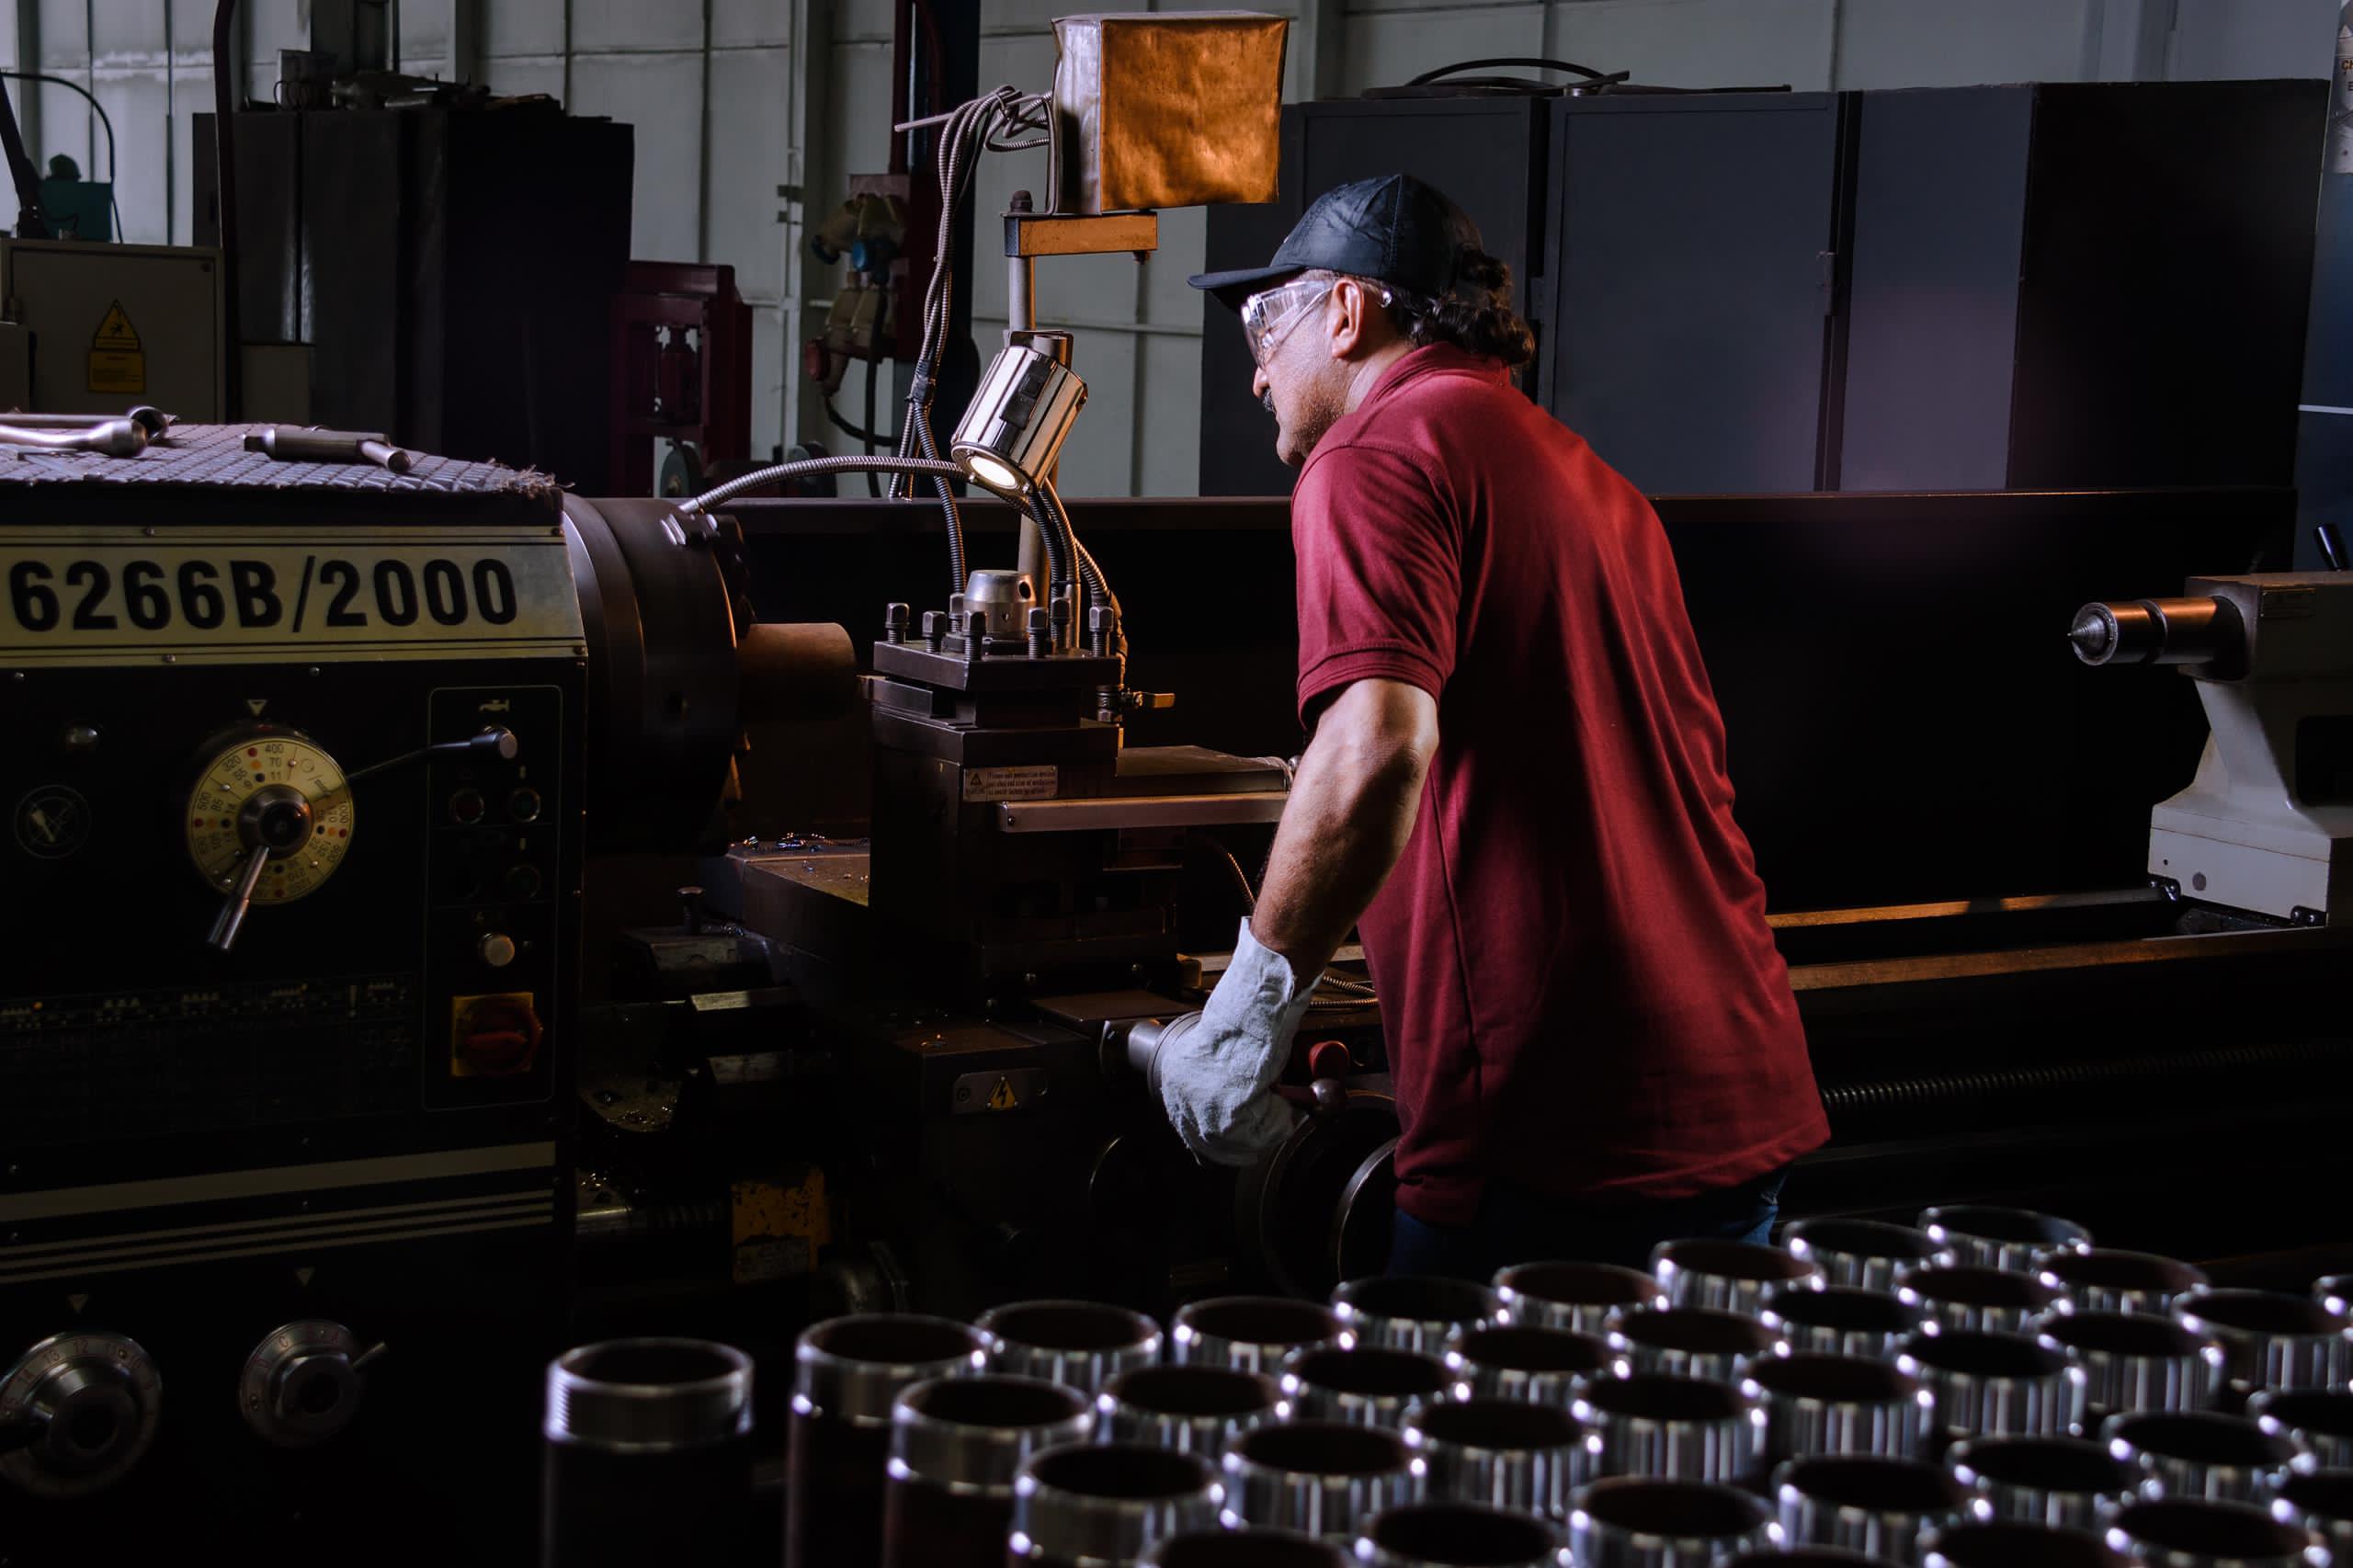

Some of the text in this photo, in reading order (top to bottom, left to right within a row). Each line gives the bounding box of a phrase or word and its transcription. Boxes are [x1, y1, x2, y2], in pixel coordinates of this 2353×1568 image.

[9, 555, 517, 632] 6266B/2000
[265, 744, 284, 754] 400
[222, 755, 242, 773] 320
